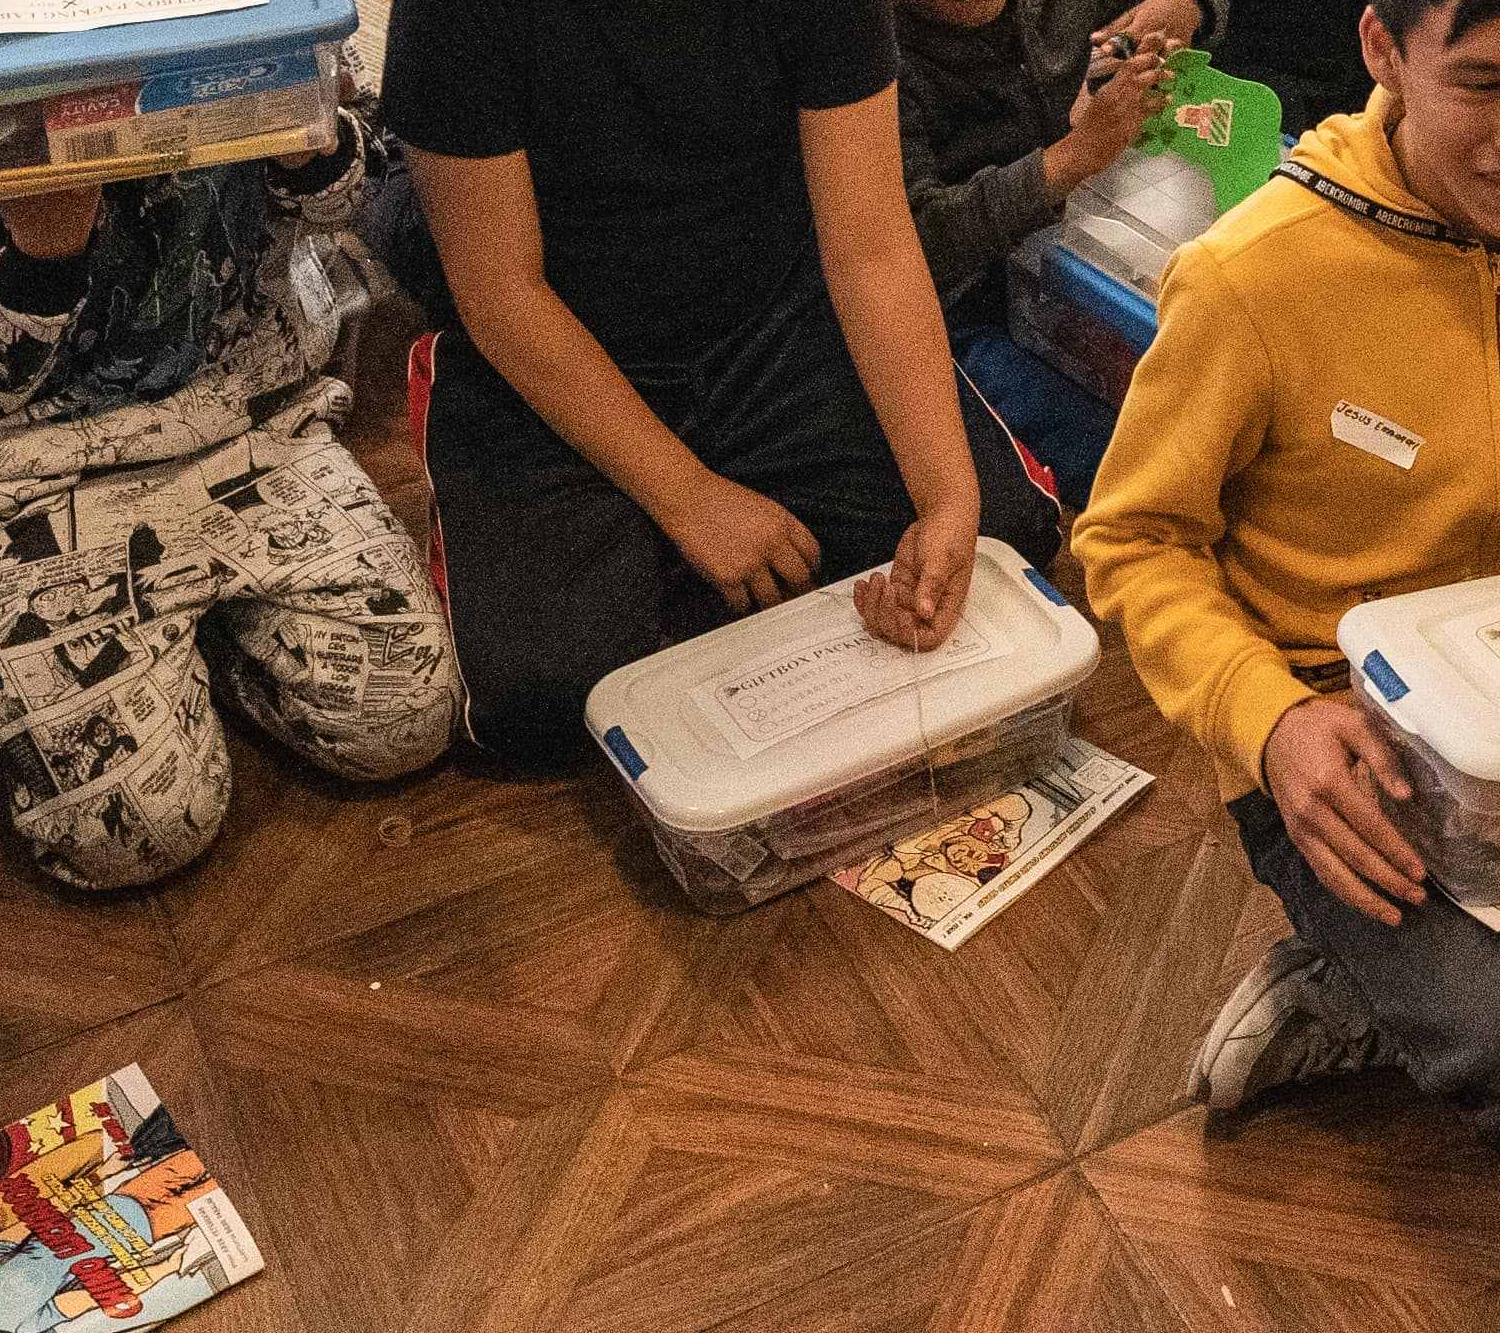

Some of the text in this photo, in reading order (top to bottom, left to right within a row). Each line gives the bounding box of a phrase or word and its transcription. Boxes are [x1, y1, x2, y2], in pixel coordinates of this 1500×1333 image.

[41, 0, 128, 21] PACKING
[1336, 402, 1371, 426] Jesus
[735, 629, 873, 692] GIFTBOX PACKIN
[69, 1255, 144, 1320] CHINO
